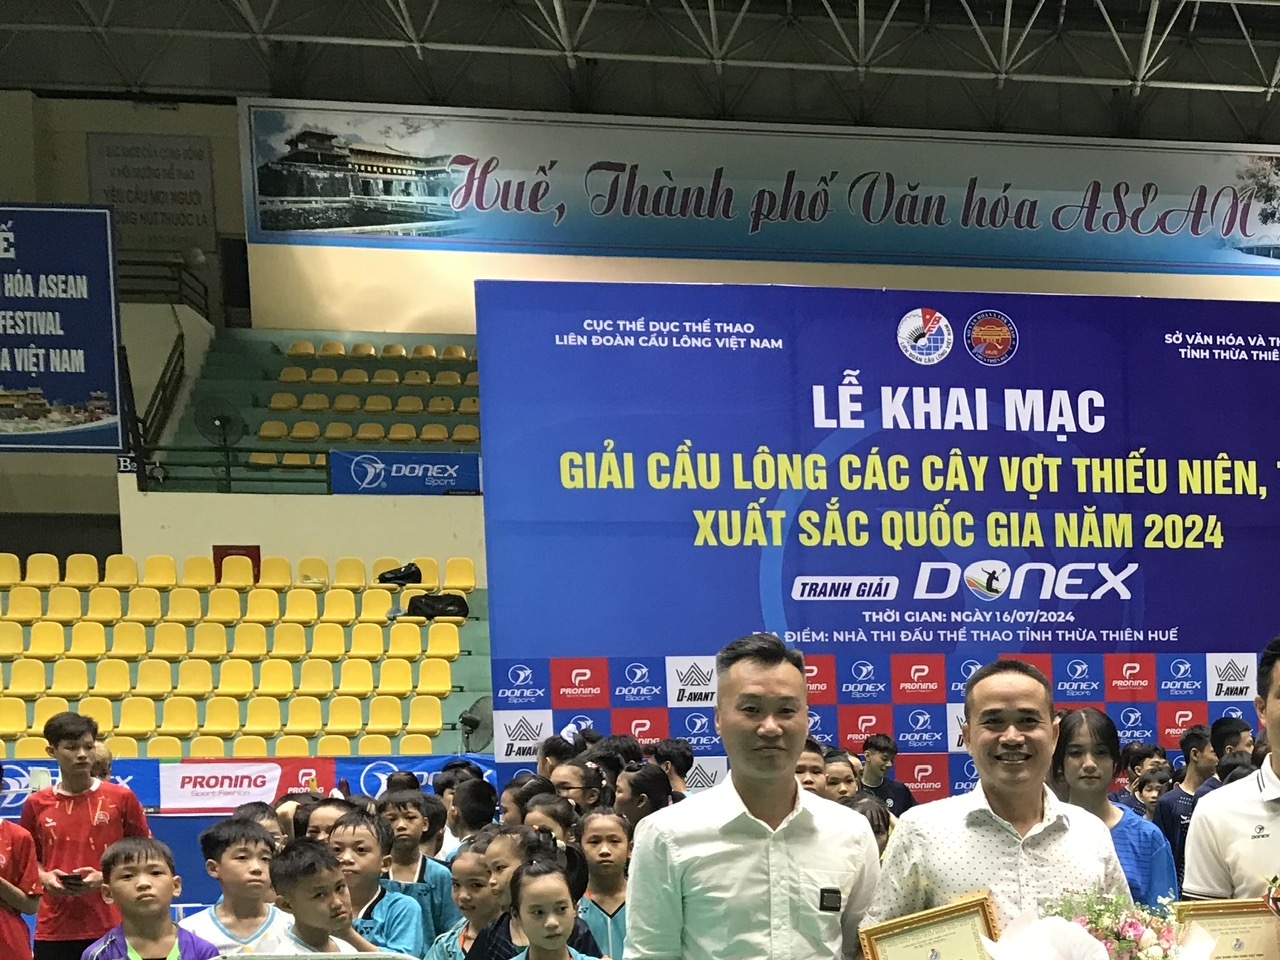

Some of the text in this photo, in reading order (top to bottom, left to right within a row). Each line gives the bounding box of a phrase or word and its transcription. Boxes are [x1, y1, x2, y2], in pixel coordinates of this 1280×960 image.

[447, 153, 1256, 237] Huế, Thành phố Văn hóa ASEAN
[38, 274, 88, 299] ASEAN
[583, 317, 755, 336] CỤC THỂ DỤC THỂ THAO
[555, 332, 783, 352] LIÊN ĐOÀN CẦU LÔNG VIỆT NAM
[1164, 330, 1184, 346] SỞ
[1185, 332, 1213, 346] VĂN
[1215, 333, 1245, 347] HÓA
[1248, 333, 1266, 348] VÀ
[14, 343, 85, 378] VIỆT NAM
[1213, 347, 1249, 361] THỪA
[812, 369, 1106, 442] LỄ KHAI MẠC
[391, 464, 459, 477] DONEX
[559, 439, 635, 490] GIẢI
[647, 439, 721, 490] CẦU
[733, 445, 828, 490] LÔNG
[839, 447, 910, 492] CÁC
[922, 448, 988, 492] CÂY
[999, 453, 1063, 500] VỢT
[1072, 447, 1167, 494] THIẾU
[1179, 452, 1267, 499] NIÊN,
[425, 477, 456, 486] Sport
[693, 496, 1224, 551] XUẤT SẮC QUỐC GIA NĂM 2024
[799, 581, 851, 598] TRANH
[856, 577, 890, 598] GIẢI
[862, 608, 1075, 624] THỜI GIAN: NGÀY 16/07/2024
[784, 627, 829, 642] ĐIỂM:
[833, 628, 866, 642] NHÀ
[871, 630, 897, 642] THI
[900, 626, 934, 642] ĐẤU
[938, 625, 967, 642] THỂ
[970, 630, 1013, 642] THAO
[1016, 627, 1052, 642] TỈNH
[1056, 628, 1098, 642] THỪA
[1100, 627, 1144, 642] THIÊN
[1148, 626, 1179, 642] HUẾ
[498, 688, 545, 698] DONEX
[615, 686, 662, 696] DONEX
[842, 683, 887, 692] DONEX
[900, 682, 938, 690] PRONING
[1057, 681, 1100, 691] DONEX
[1161, 680, 1202, 690] DONEX
[899, 732, 943, 741] DONEX
[180, 774, 267, 790] PRONING
